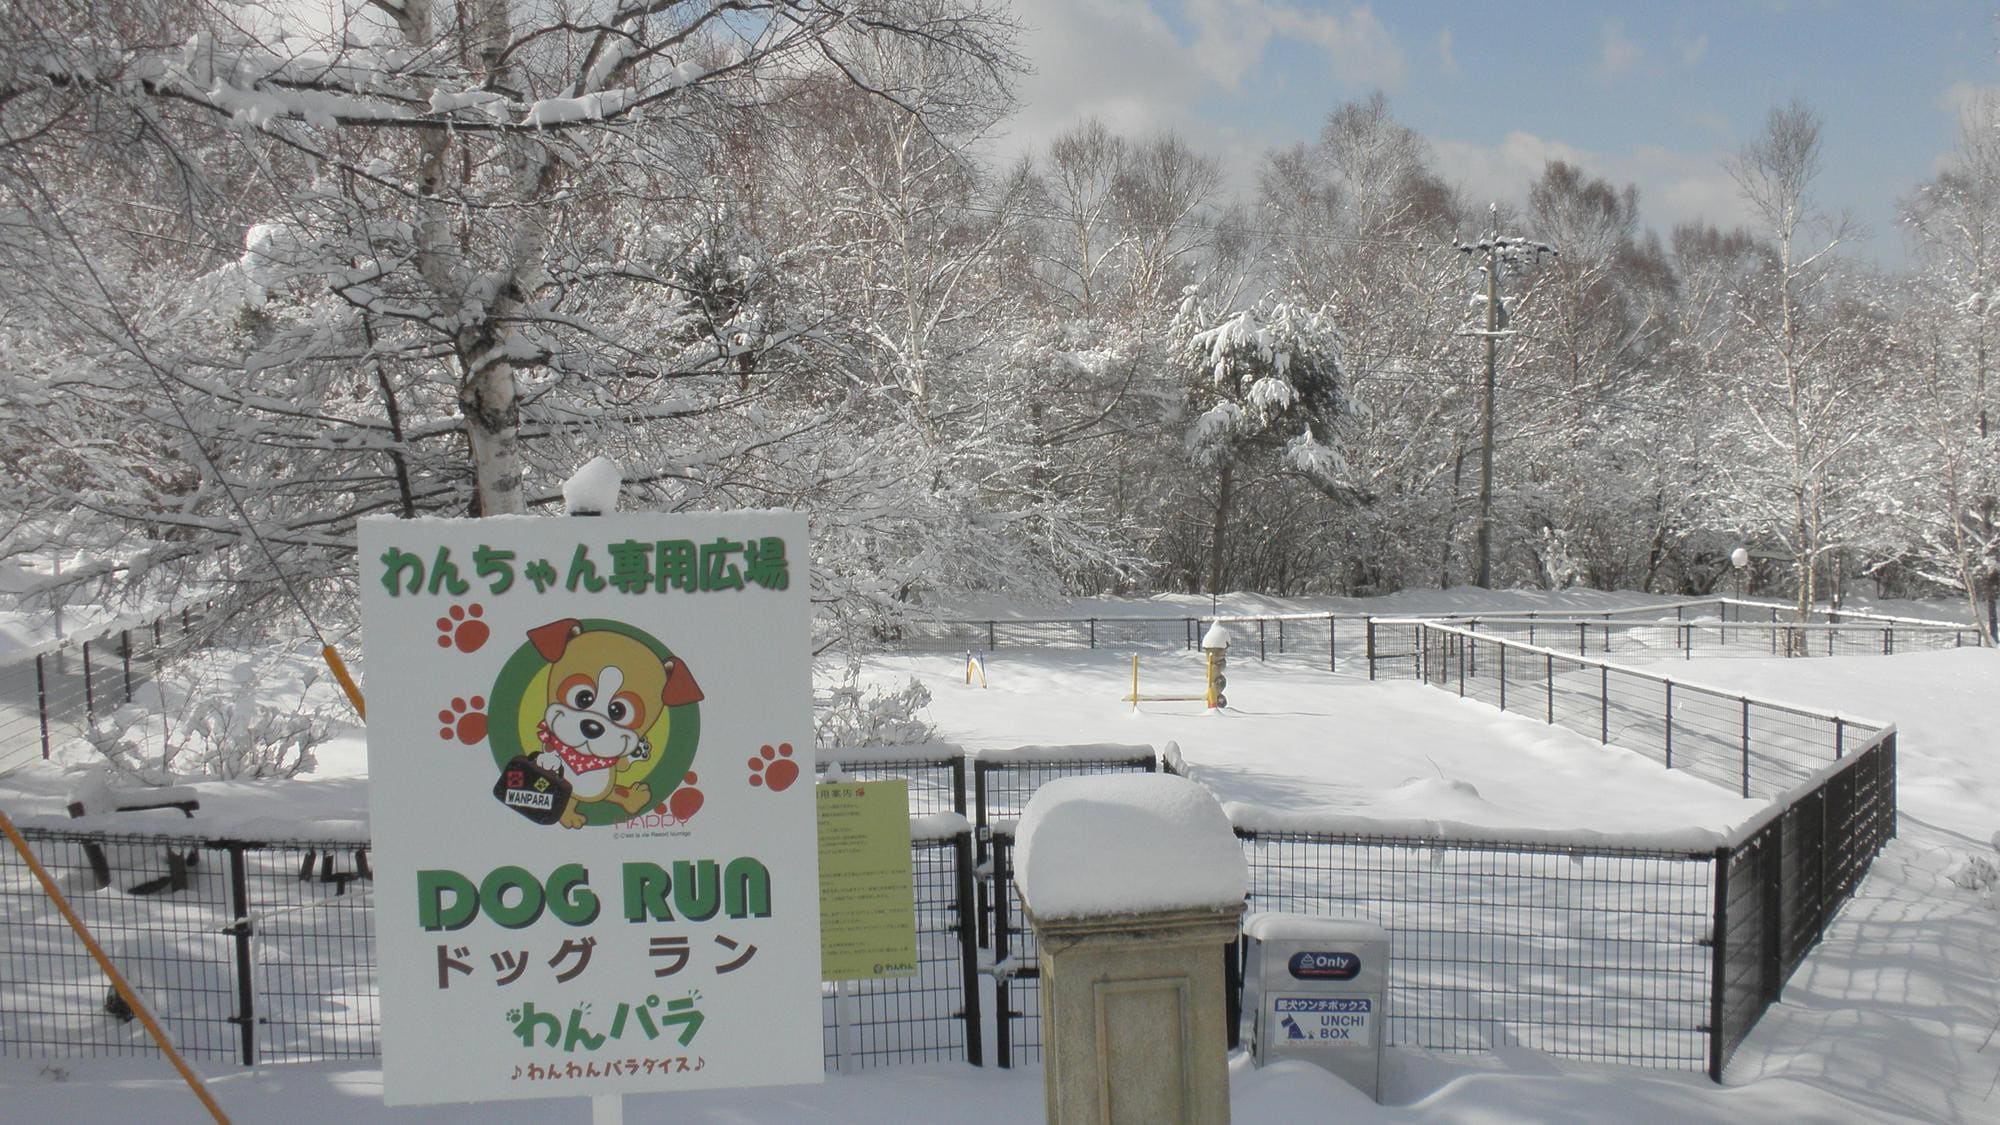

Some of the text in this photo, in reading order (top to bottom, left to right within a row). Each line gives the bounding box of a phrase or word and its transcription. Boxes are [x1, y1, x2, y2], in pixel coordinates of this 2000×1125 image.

[380, 536, 789, 596] わんちゃん専用広場
[508, 790, 551, 807] WANPARA
[417, 857, 772, 931] DOG RUN
[437, 935, 757, 989] ドッグ ラン
[1316, 956, 1349, 968] Only
[512, 994, 705, 1052] わんパラ
[1320, 1015, 1365, 1026] UNCHI
[1320, 1028, 1349, 1039] BOX
